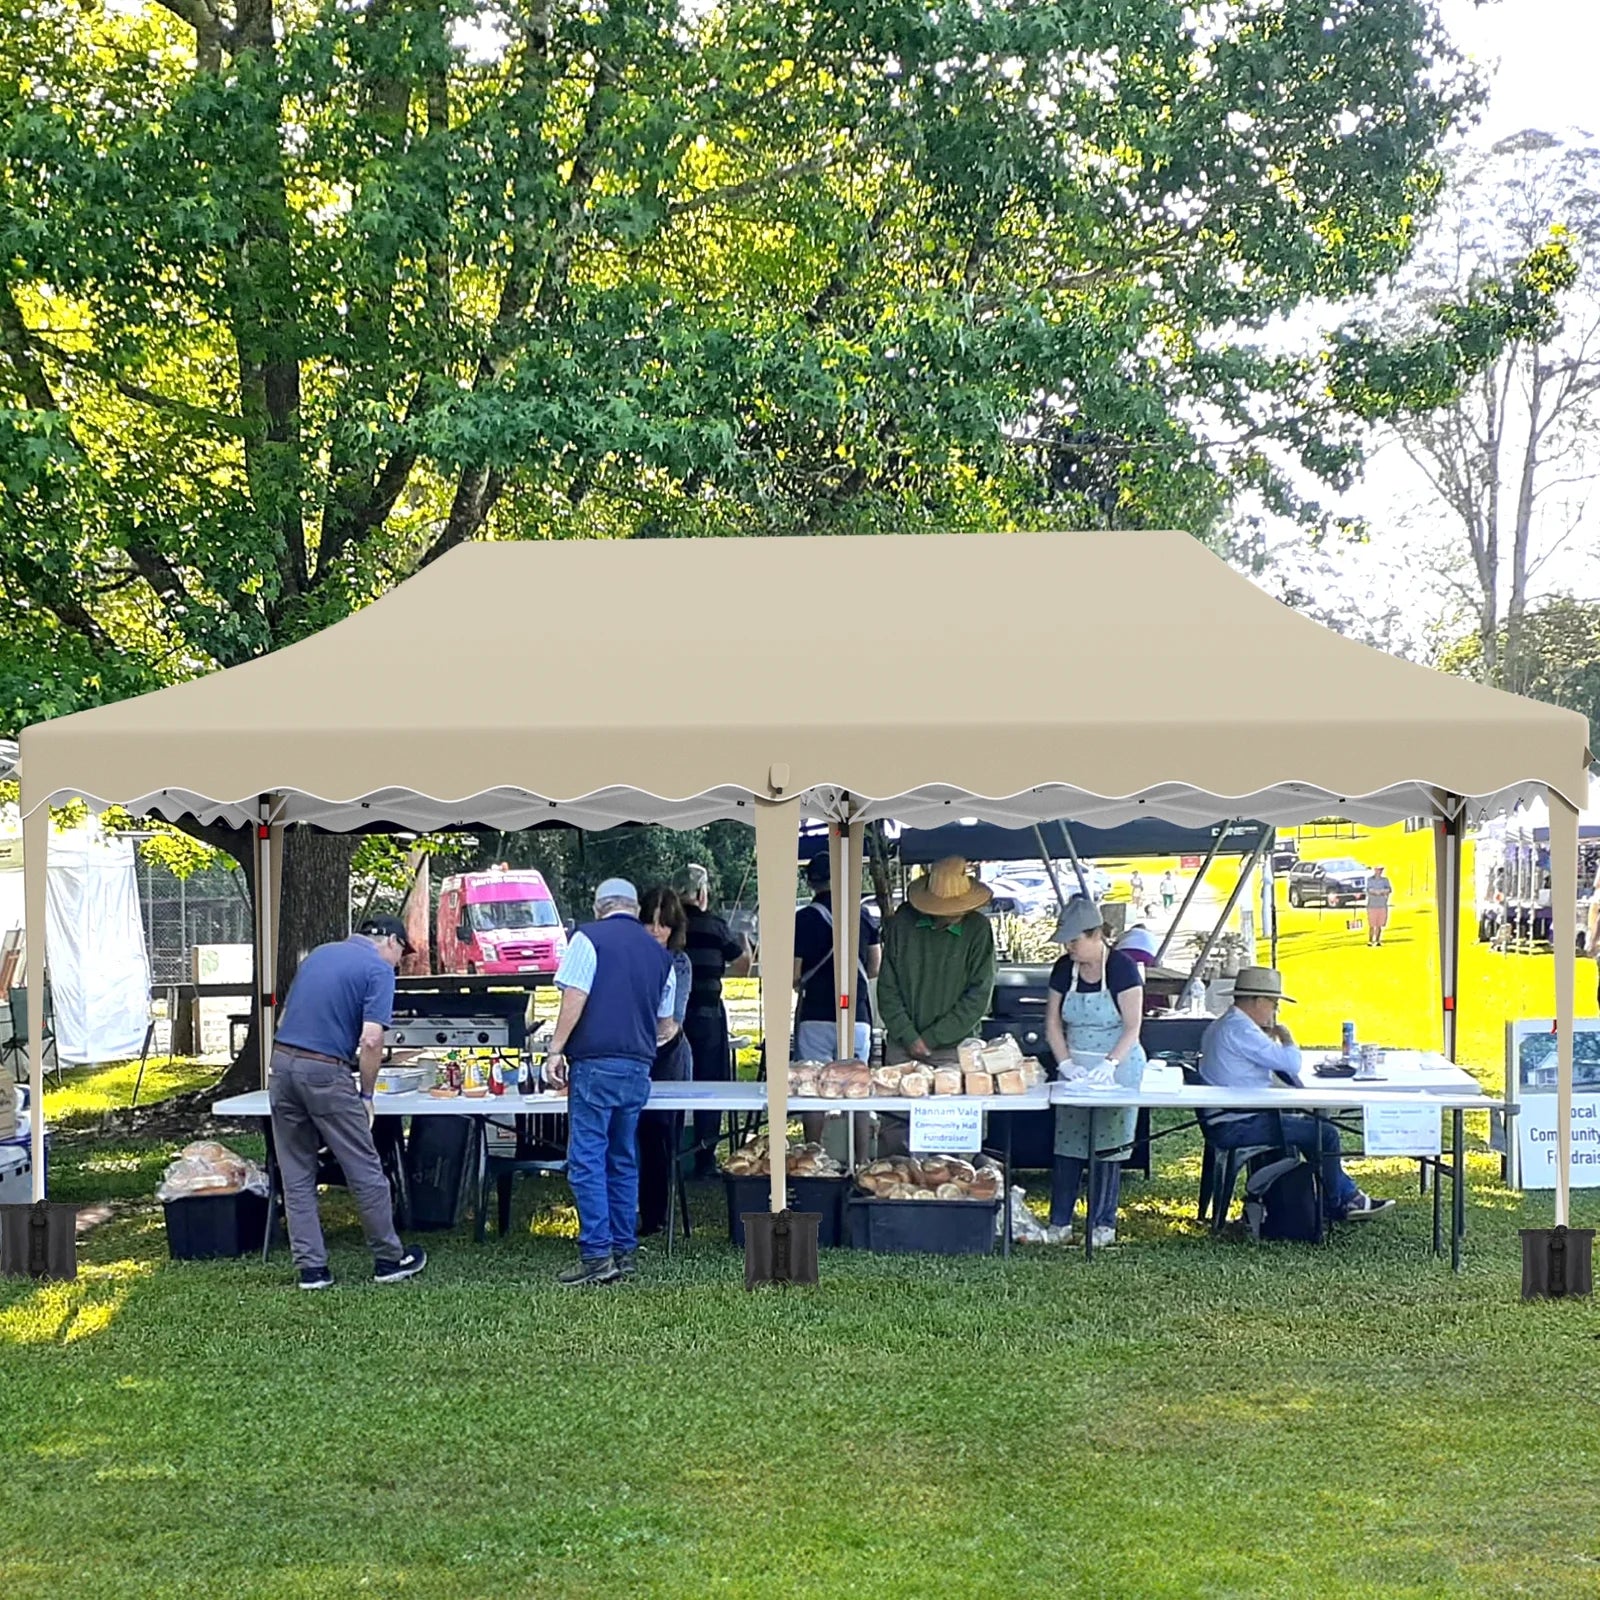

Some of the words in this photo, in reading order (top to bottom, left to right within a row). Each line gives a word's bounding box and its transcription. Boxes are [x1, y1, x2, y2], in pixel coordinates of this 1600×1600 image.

[914, 1107, 955, 1116] Hannam
[957, 1107, 979, 1117] Vale
[1570, 1103, 1597, 1118] ocal
[923, 1133, 968, 1141] Fundraiser
[1530, 1127, 1600, 1144] Comunity
